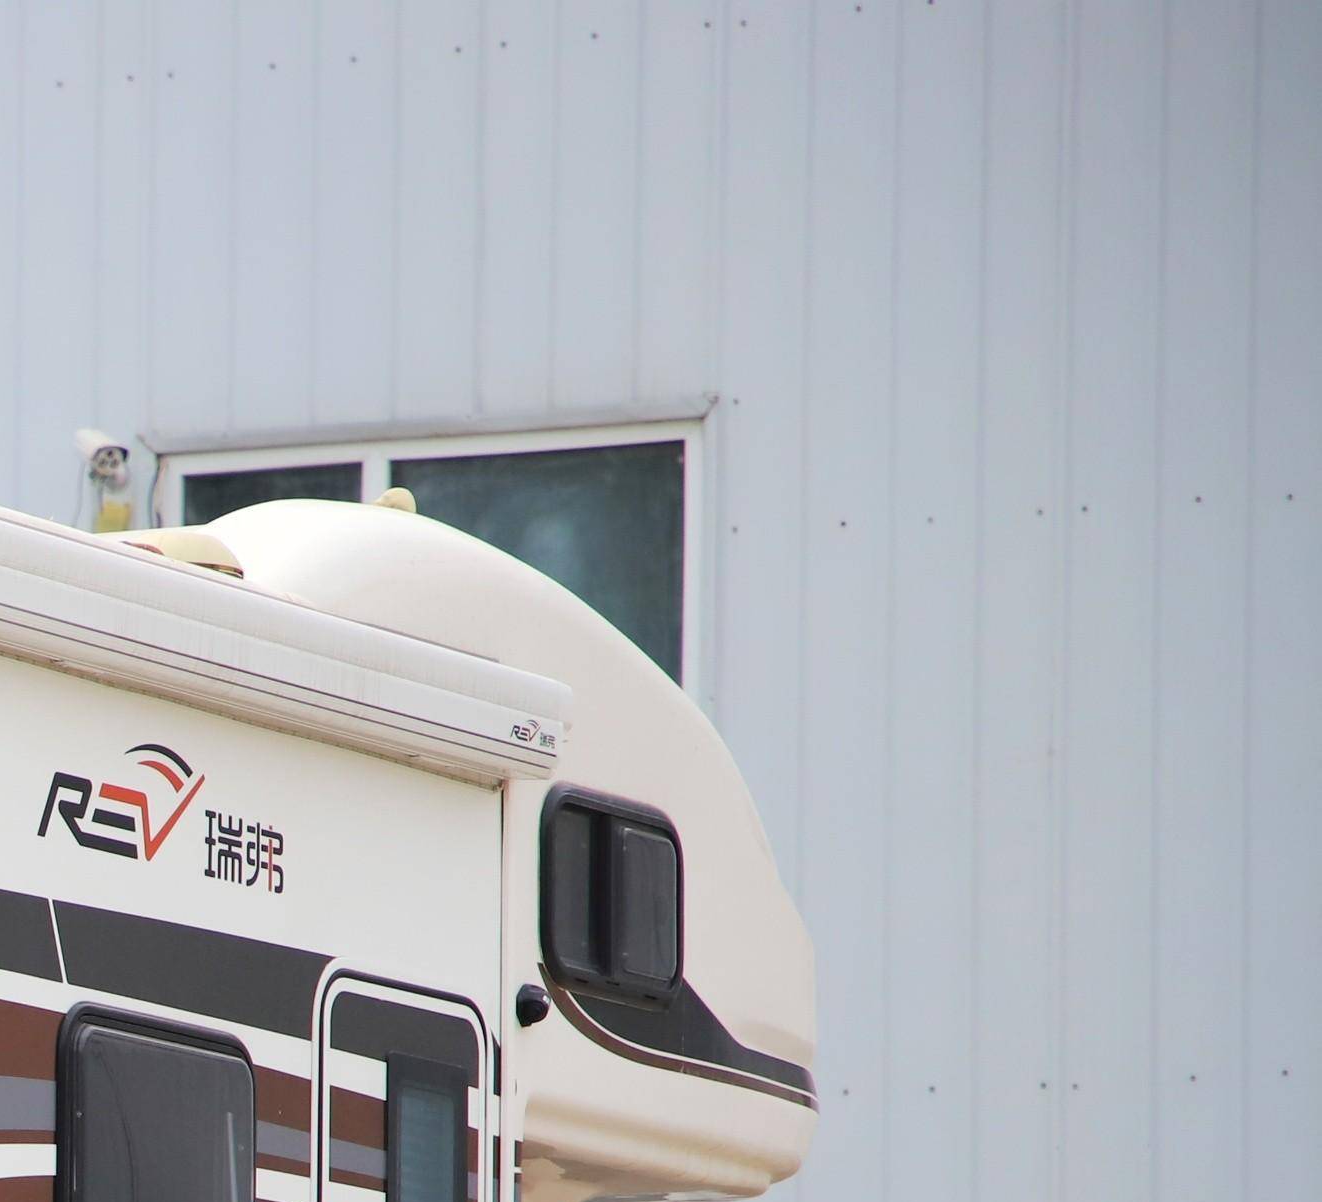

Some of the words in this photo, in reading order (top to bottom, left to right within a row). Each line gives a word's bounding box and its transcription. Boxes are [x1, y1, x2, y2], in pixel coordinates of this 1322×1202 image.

[510, 722, 542, 743] REV
[37, 771, 206, 862] REV
[204, 809, 284, 894] 瑞弗
